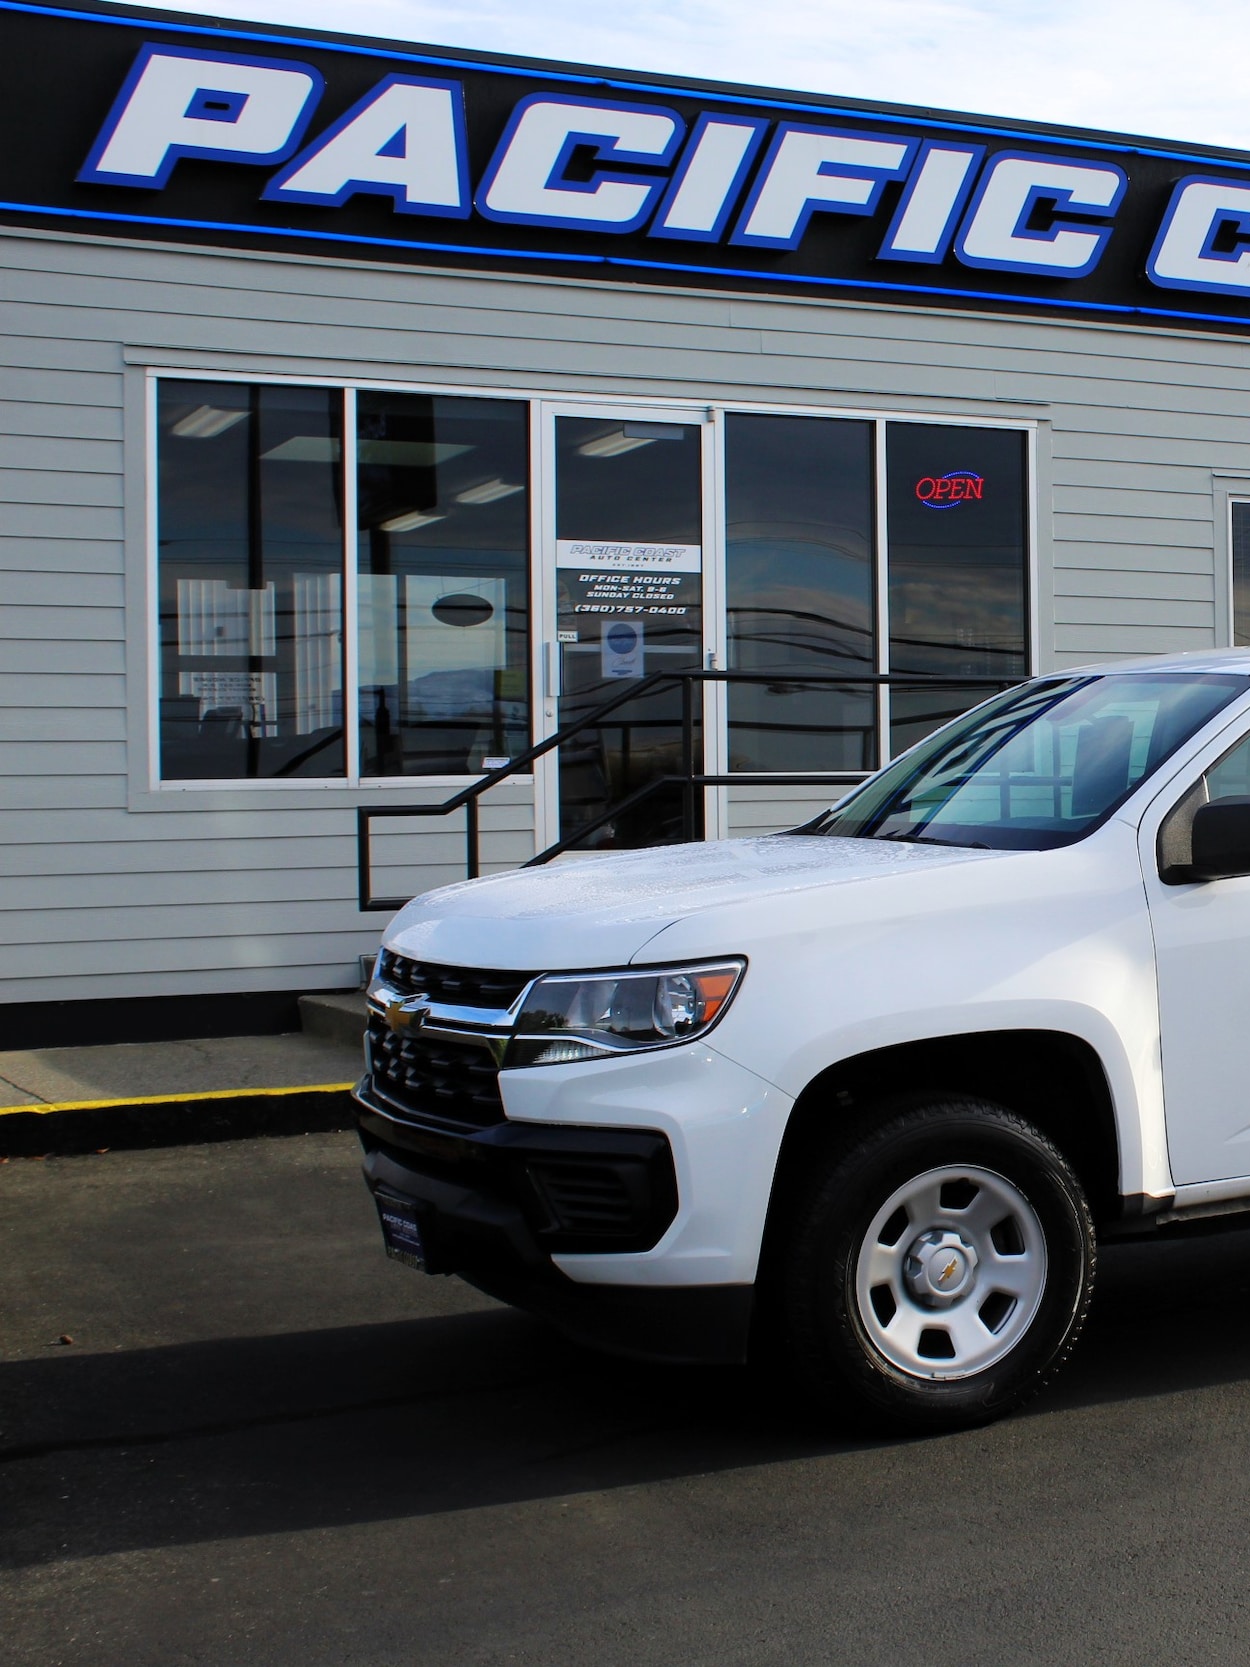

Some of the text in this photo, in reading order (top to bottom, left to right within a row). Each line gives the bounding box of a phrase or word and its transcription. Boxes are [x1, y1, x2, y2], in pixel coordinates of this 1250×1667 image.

[76, 42, 1129, 280] PACIFIC
[915, 477, 984, 500] OPEN
[570, 544, 686, 558] PACIFIC COAST
[579, 574, 682, 585] OFFICE HOURS
[632, 592, 675, 600] CLOSED
[574, 604, 687, 615] (360)757-0400
